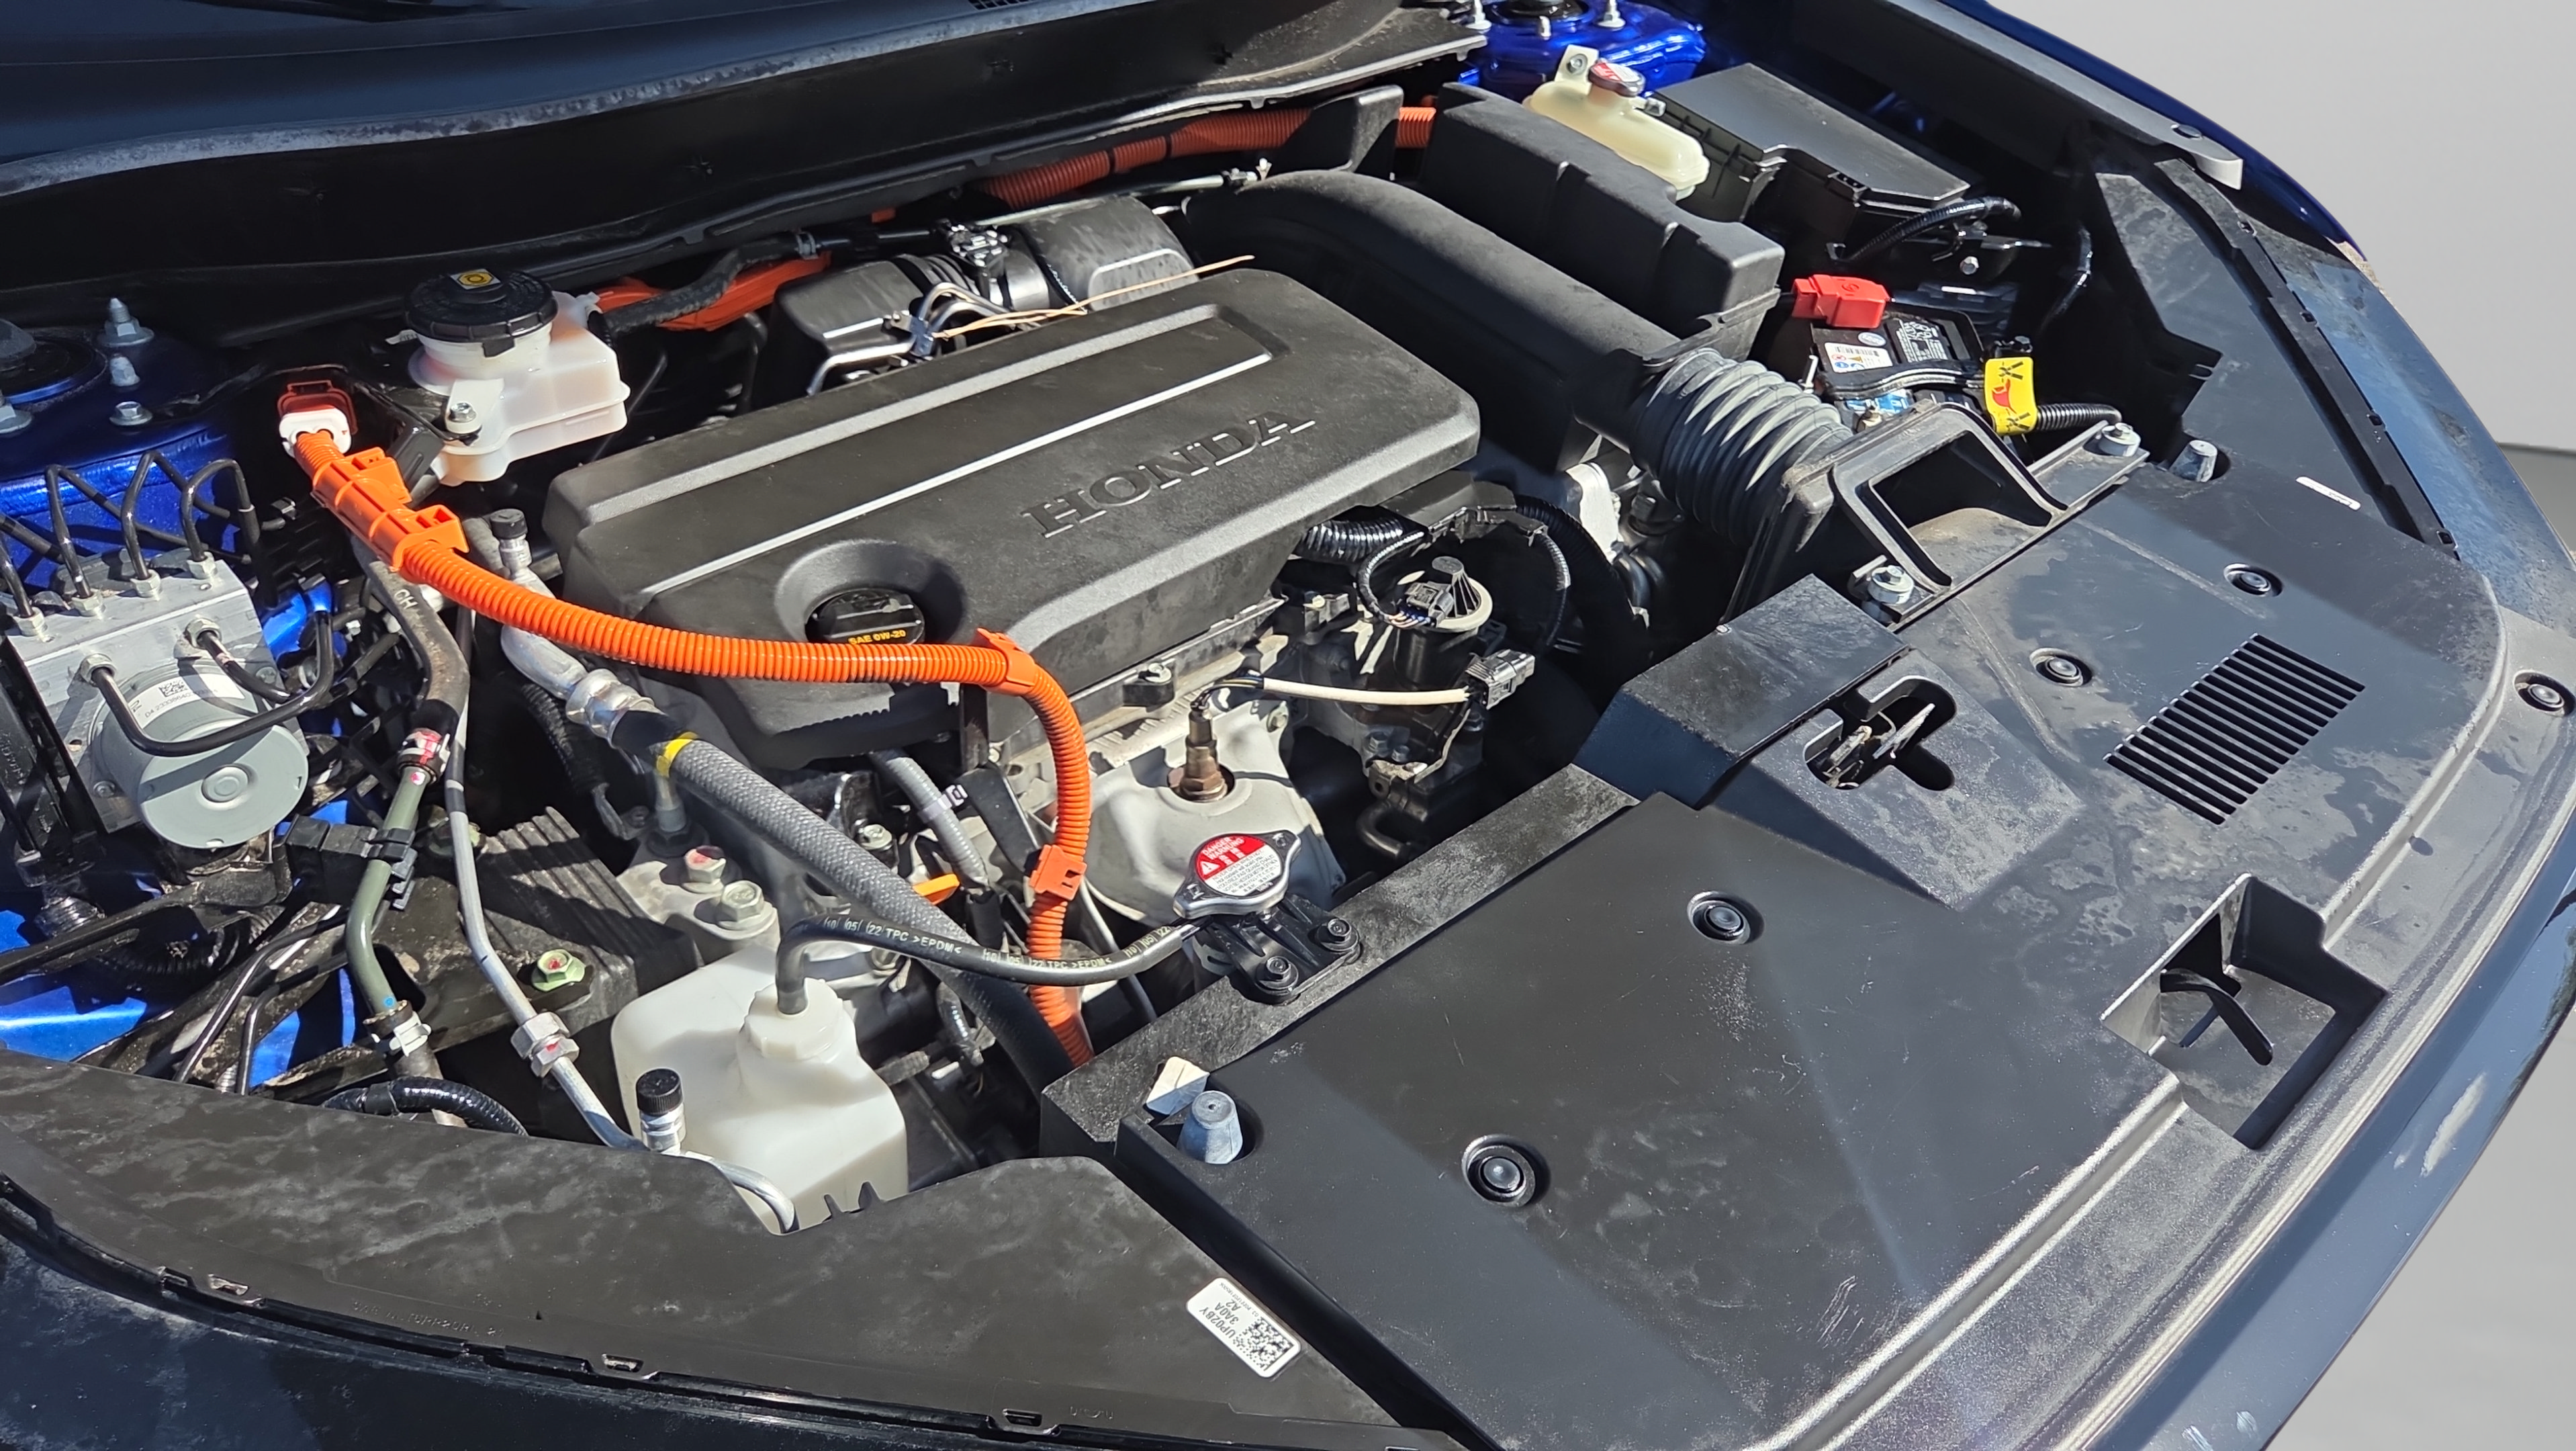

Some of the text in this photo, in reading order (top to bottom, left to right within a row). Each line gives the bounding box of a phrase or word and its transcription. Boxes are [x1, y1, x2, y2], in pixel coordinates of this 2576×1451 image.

[1020, 411, 1316, 539] HONDA
[848, 629, 907, 644] SAE 0W-20
[1203, 837, 1232, 856] DANGER
[1208, 838, 1245, 861] WARNUNG
[1214, 1301, 1240, 1325] 3A0A
[1226, 1299, 1242, 1311] A2
[1199, 1307, 1236, 1339] UP02BY
